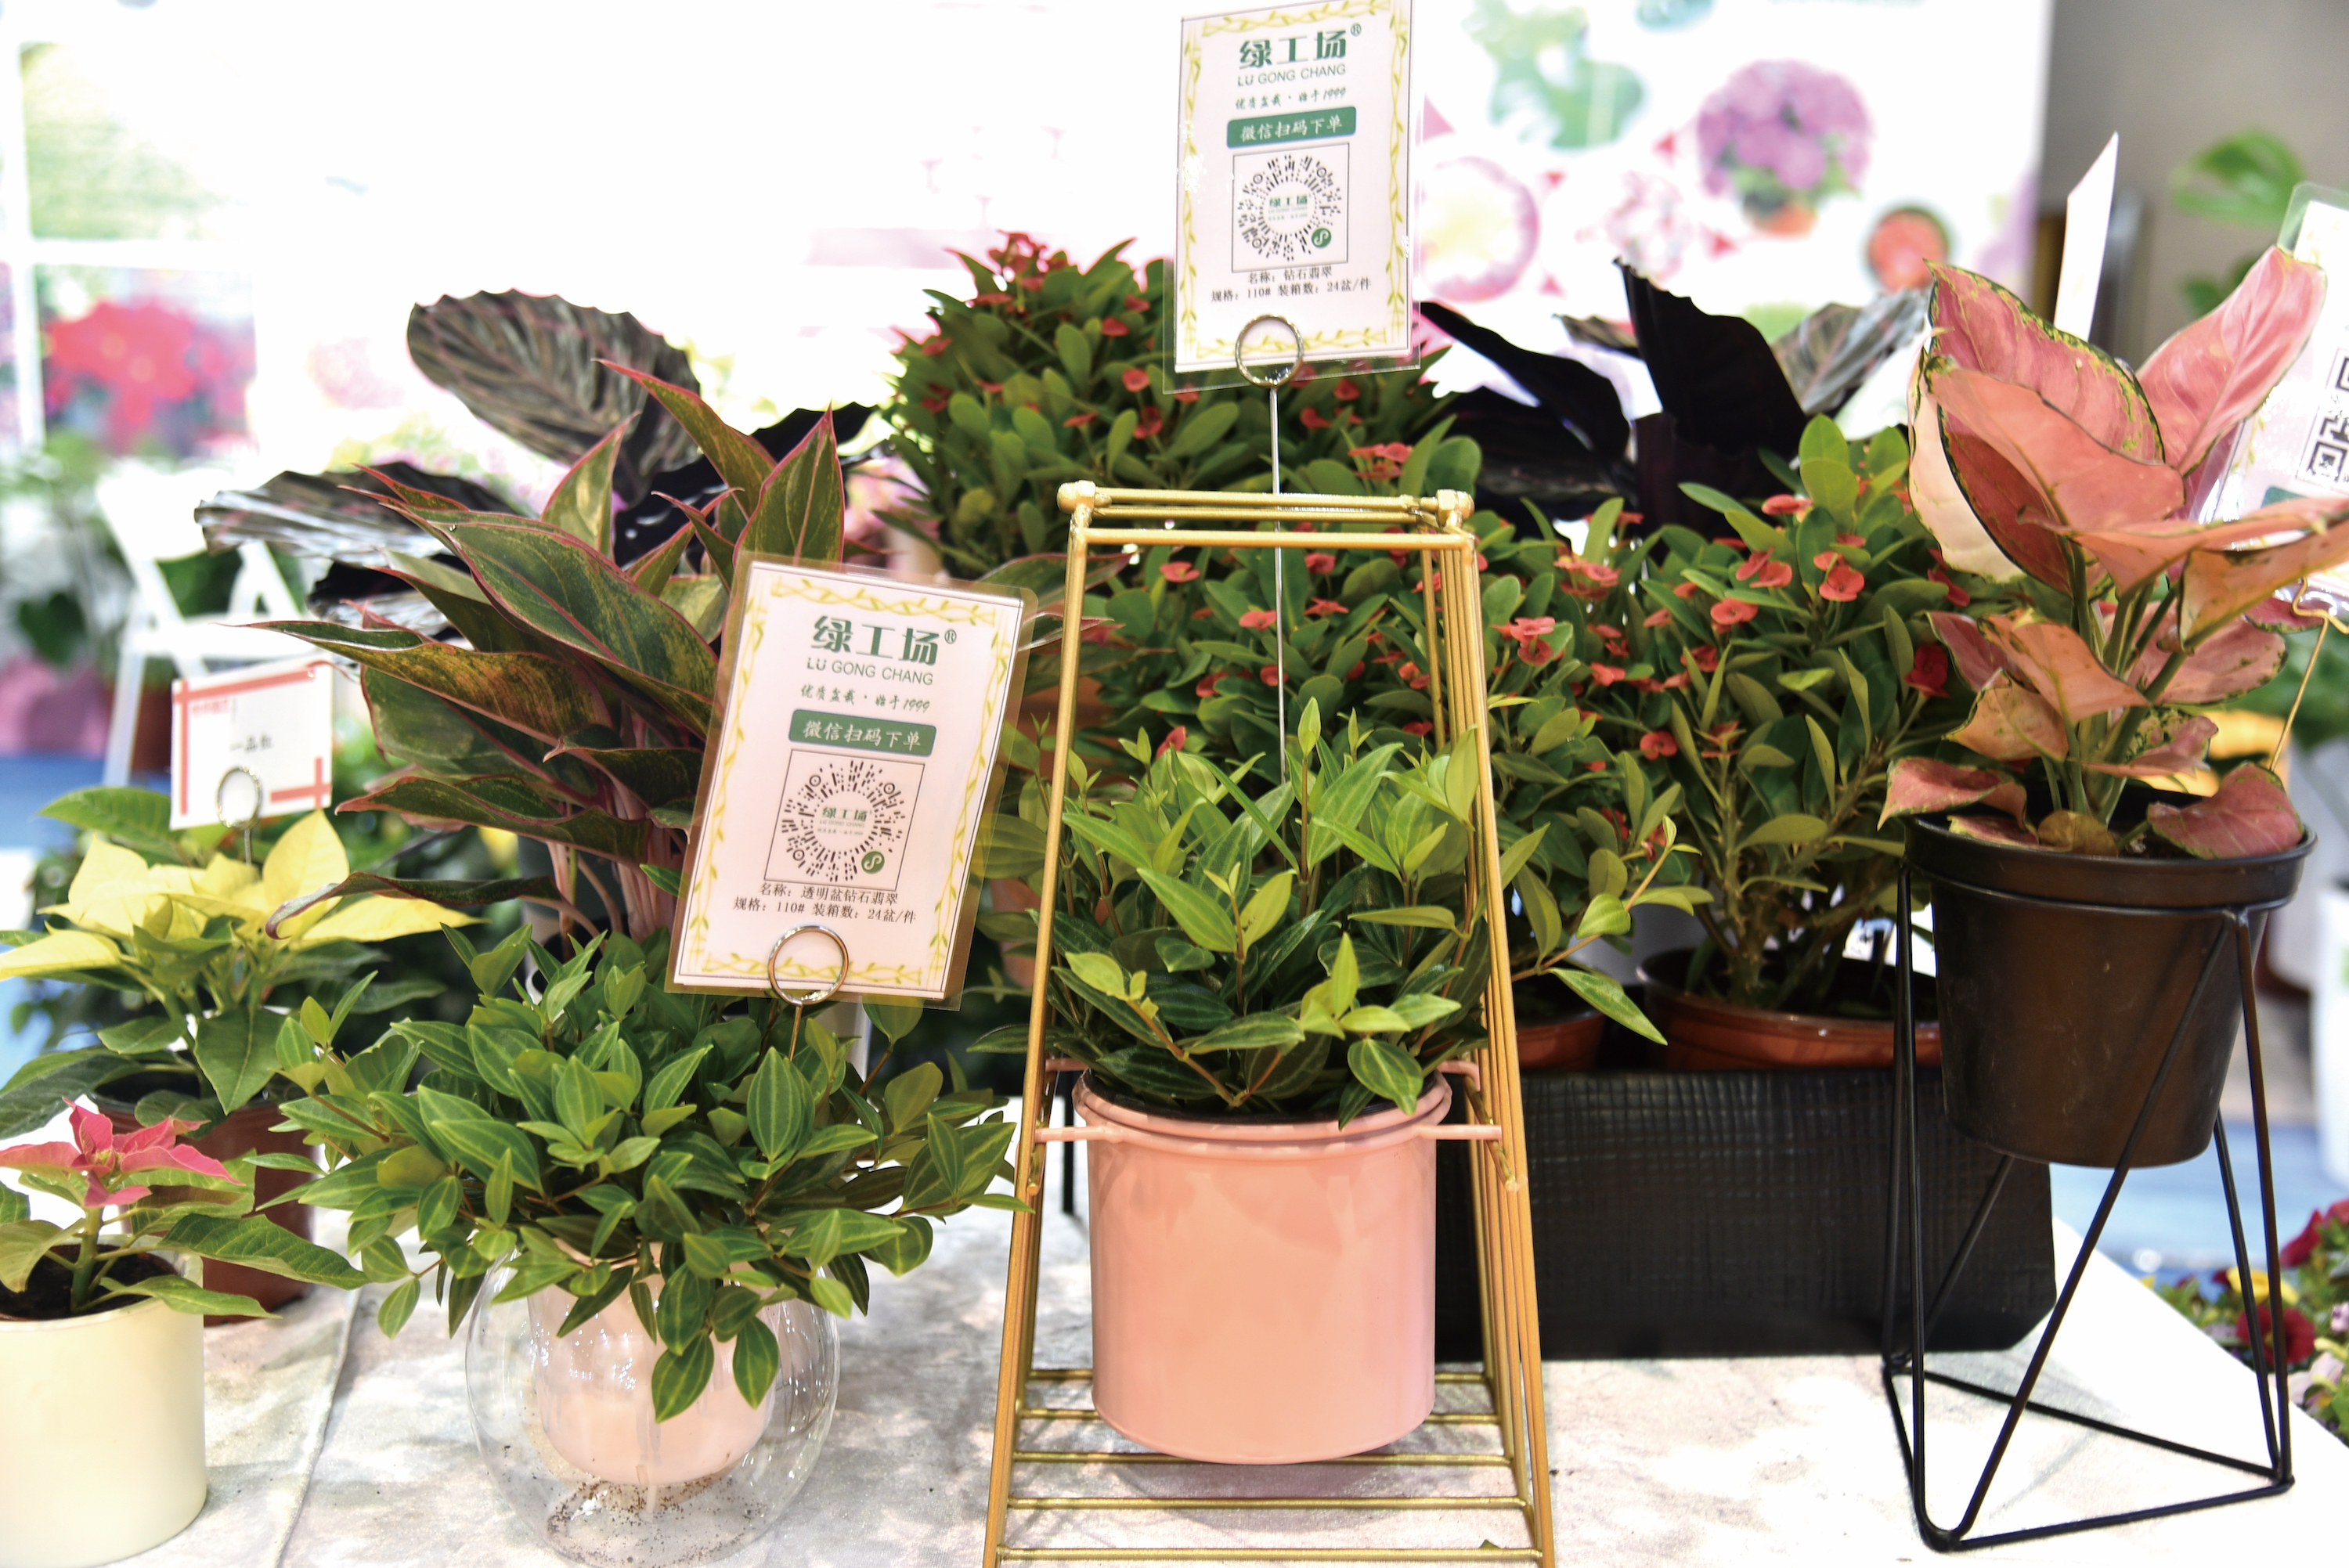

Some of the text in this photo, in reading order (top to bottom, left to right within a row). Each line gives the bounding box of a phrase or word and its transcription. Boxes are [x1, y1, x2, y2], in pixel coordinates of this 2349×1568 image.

[1238, 63, 1346, 87] LU GONG CHANG
[1240, 114, 1342, 142] 微信扫码下单
[806, 657, 934, 686] LU GONG CHANG
[803, 719, 921, 752] 微信扫码下单
